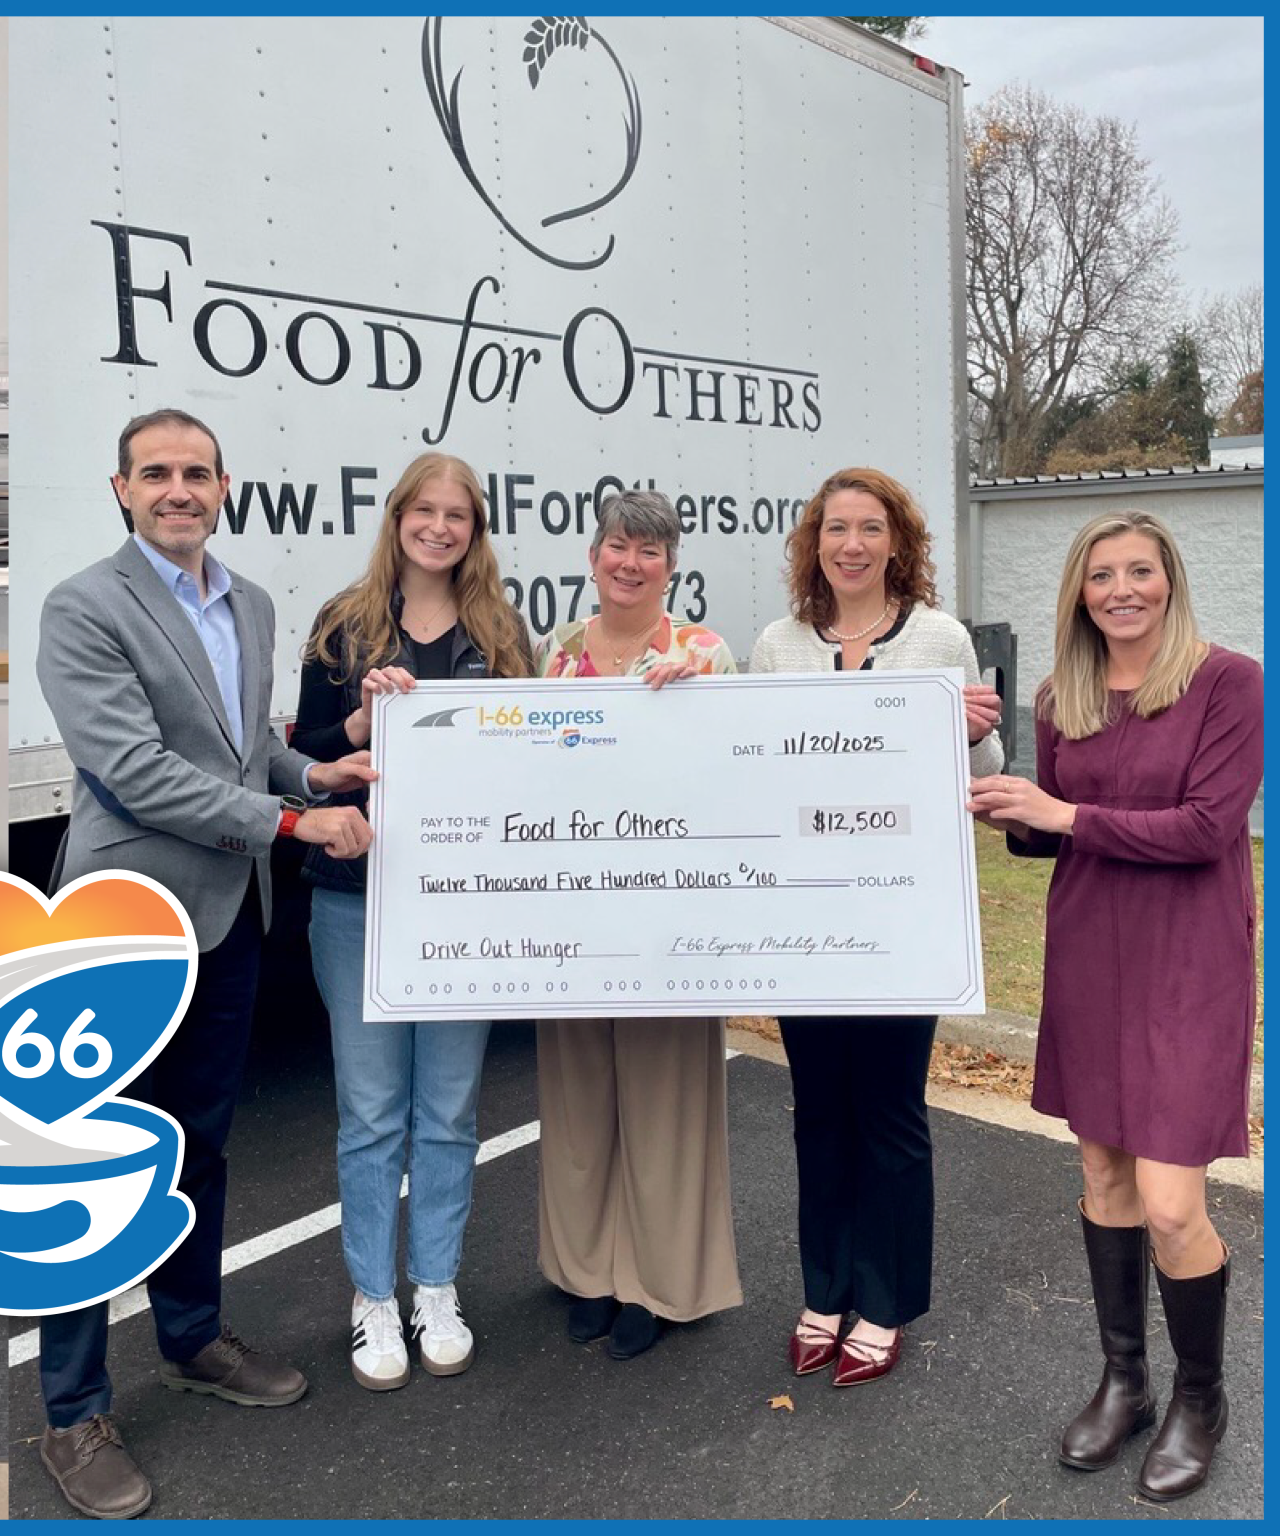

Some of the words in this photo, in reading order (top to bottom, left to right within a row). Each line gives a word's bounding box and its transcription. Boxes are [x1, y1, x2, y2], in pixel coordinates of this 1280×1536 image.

[91, 219, 422, 391] FOOD
[422, 275, 542, 446] for
[562, 306, 822, 434] OTHERS
[874, 697, 907, 708] 0001
[478, 705, 524, 727] I-66
[528, 709, 605, 730] express
[478, 727, 514, 738] mobility
[515, 727, 553, 738] partners
[581, 735, 617, 746] Express
[783, 731, 885, 755] 11/20/2025
[732, 745, 765, 756] DATE
[420, 817, 443, 828] PAY
[446, 816, 463, 827] TO
[466, 815, 491, 827] THE
[504, 812, 555, 842] Food
[569, 809, 604, 840] for
[615, 809, 689, 839] Others
[812, 809, 897, 835] $12,500
[420, 832, 463, 844] ORDER
[466, 832, 484, 843] OF
[418, 874, 467, 893] Twelve
[473, 873, 548, 891] Thousand
[557, 871, 593, 891] Five
[600, 869, 667, 889] Hundred
[675, 868, 732, 889] Dollars
[857, 875, 915, 887] DOLLARS
[421, 941, 471, 960] Drive
[480, 936, 513, 958] Out
[520, 938, 583, 967] Hunger
[671, 936, 705, 952] I-66
[708, 936, 754, 957] Express
[758, 936, 818, 956] Mobility
[822, 934, 879, 952] Partners
